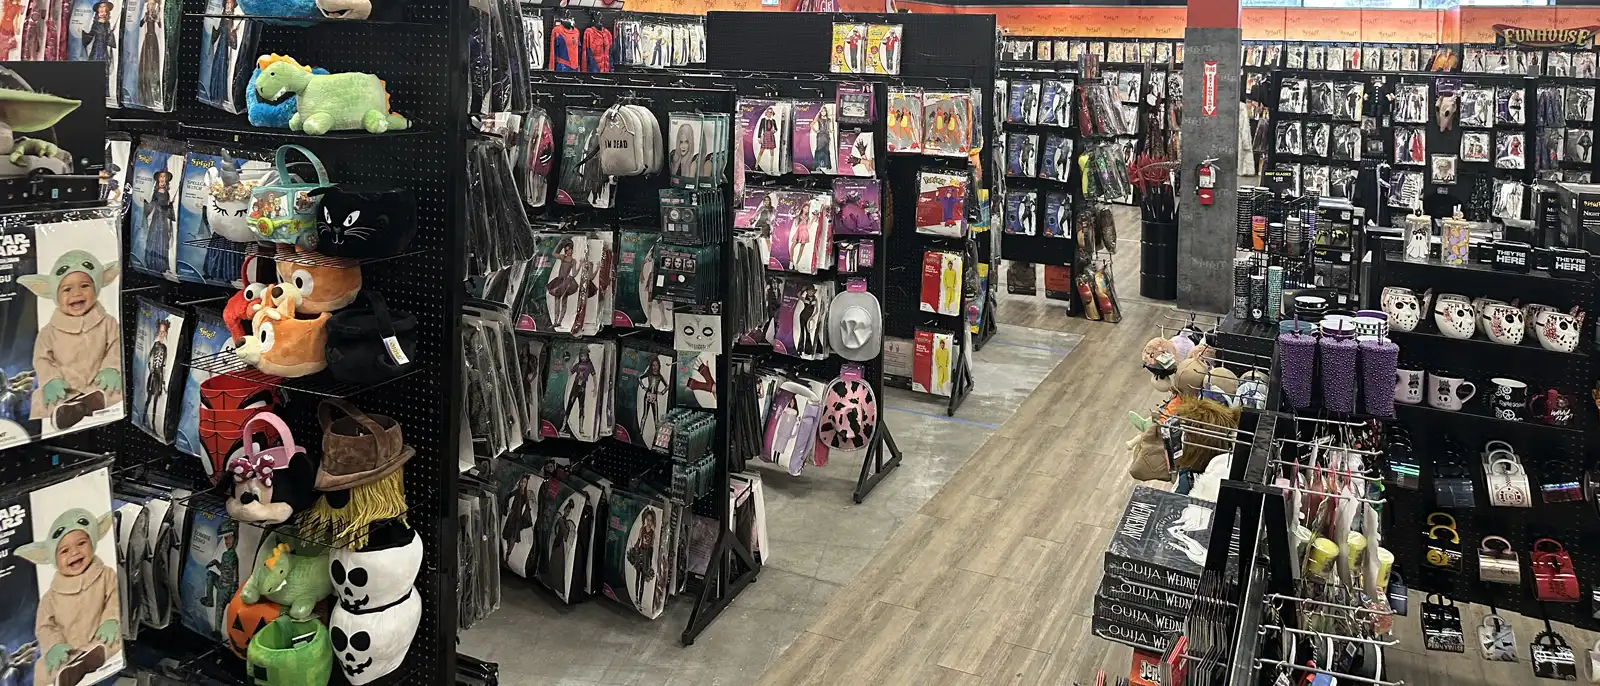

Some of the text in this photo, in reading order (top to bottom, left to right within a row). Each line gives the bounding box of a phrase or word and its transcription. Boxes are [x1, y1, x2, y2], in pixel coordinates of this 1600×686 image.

[1503, 28, 1590, 49] FUNHOUSE
[613, 139, 628, 149] DEAD
[1496, 249, 1526, 258] THEY'RE
[1496, 254, 1526, 266] HERE
[1555, 256, 1586, 265] THEY'RE
[1555, 261, 1586, 272] HERE
[1118, 500, 1157, 541] WEDNESDAY
[1122, 561, 1161, 580] OUIJA
[1120, 583, 1160, 601] OUIJA
[1111, 604, 1150, 623] OUIJA
[1108, 624, 1148, 643] OUIJA
